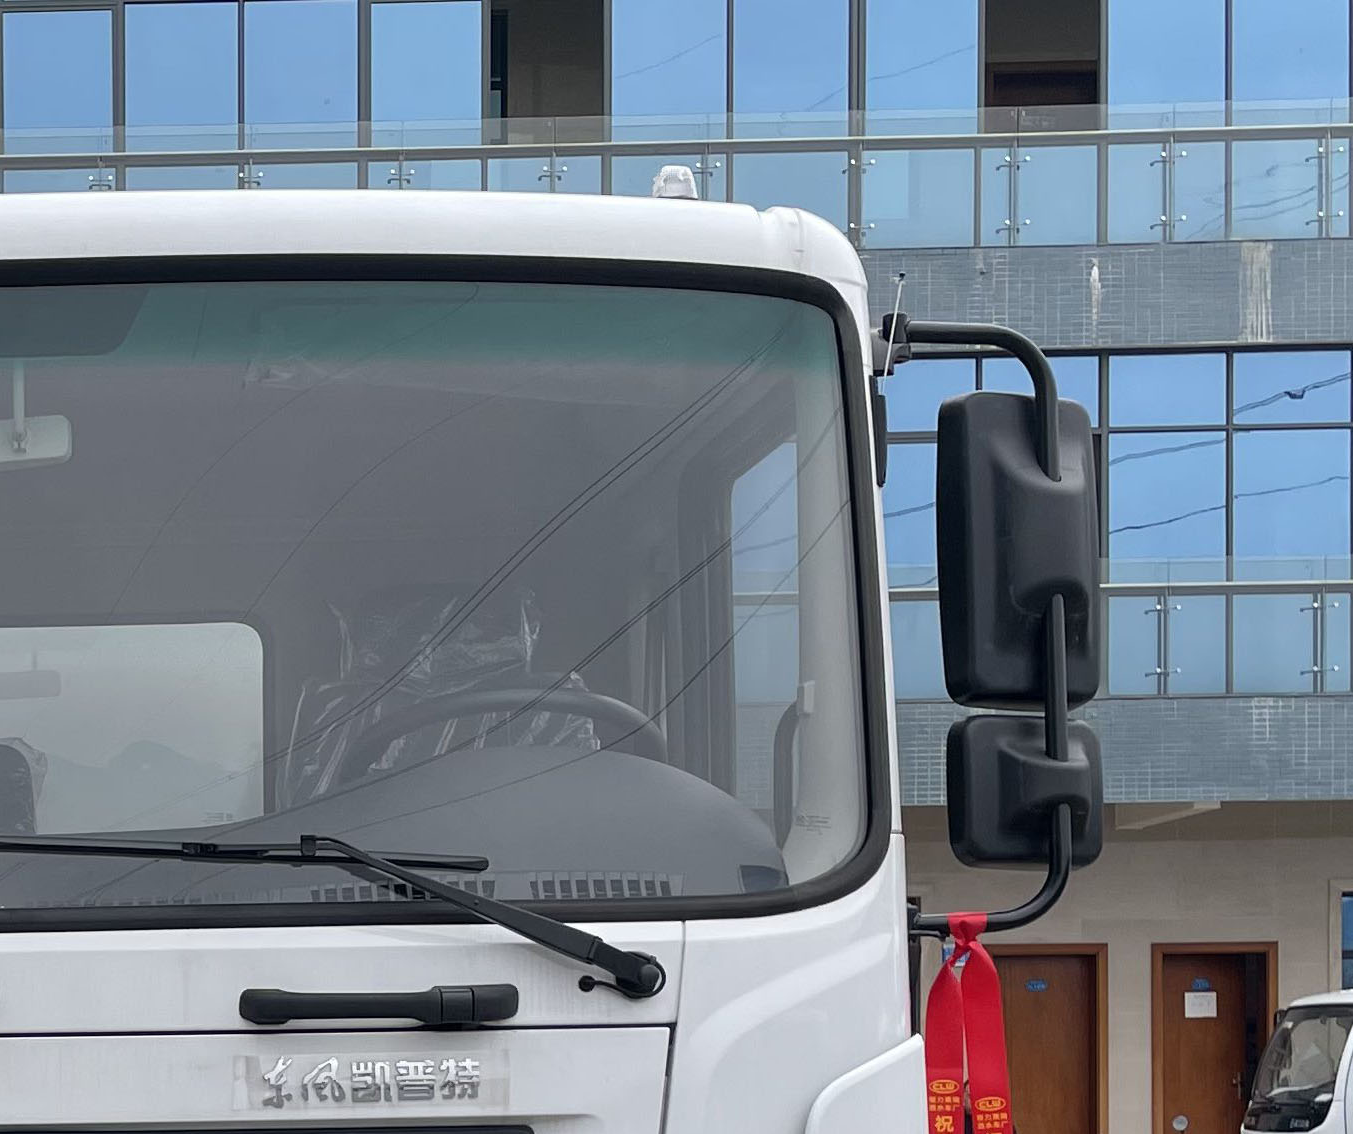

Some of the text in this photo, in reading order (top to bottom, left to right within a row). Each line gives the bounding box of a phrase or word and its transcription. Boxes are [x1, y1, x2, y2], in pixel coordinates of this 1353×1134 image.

[262, 1055, 481, 1109] 东风凯普特
